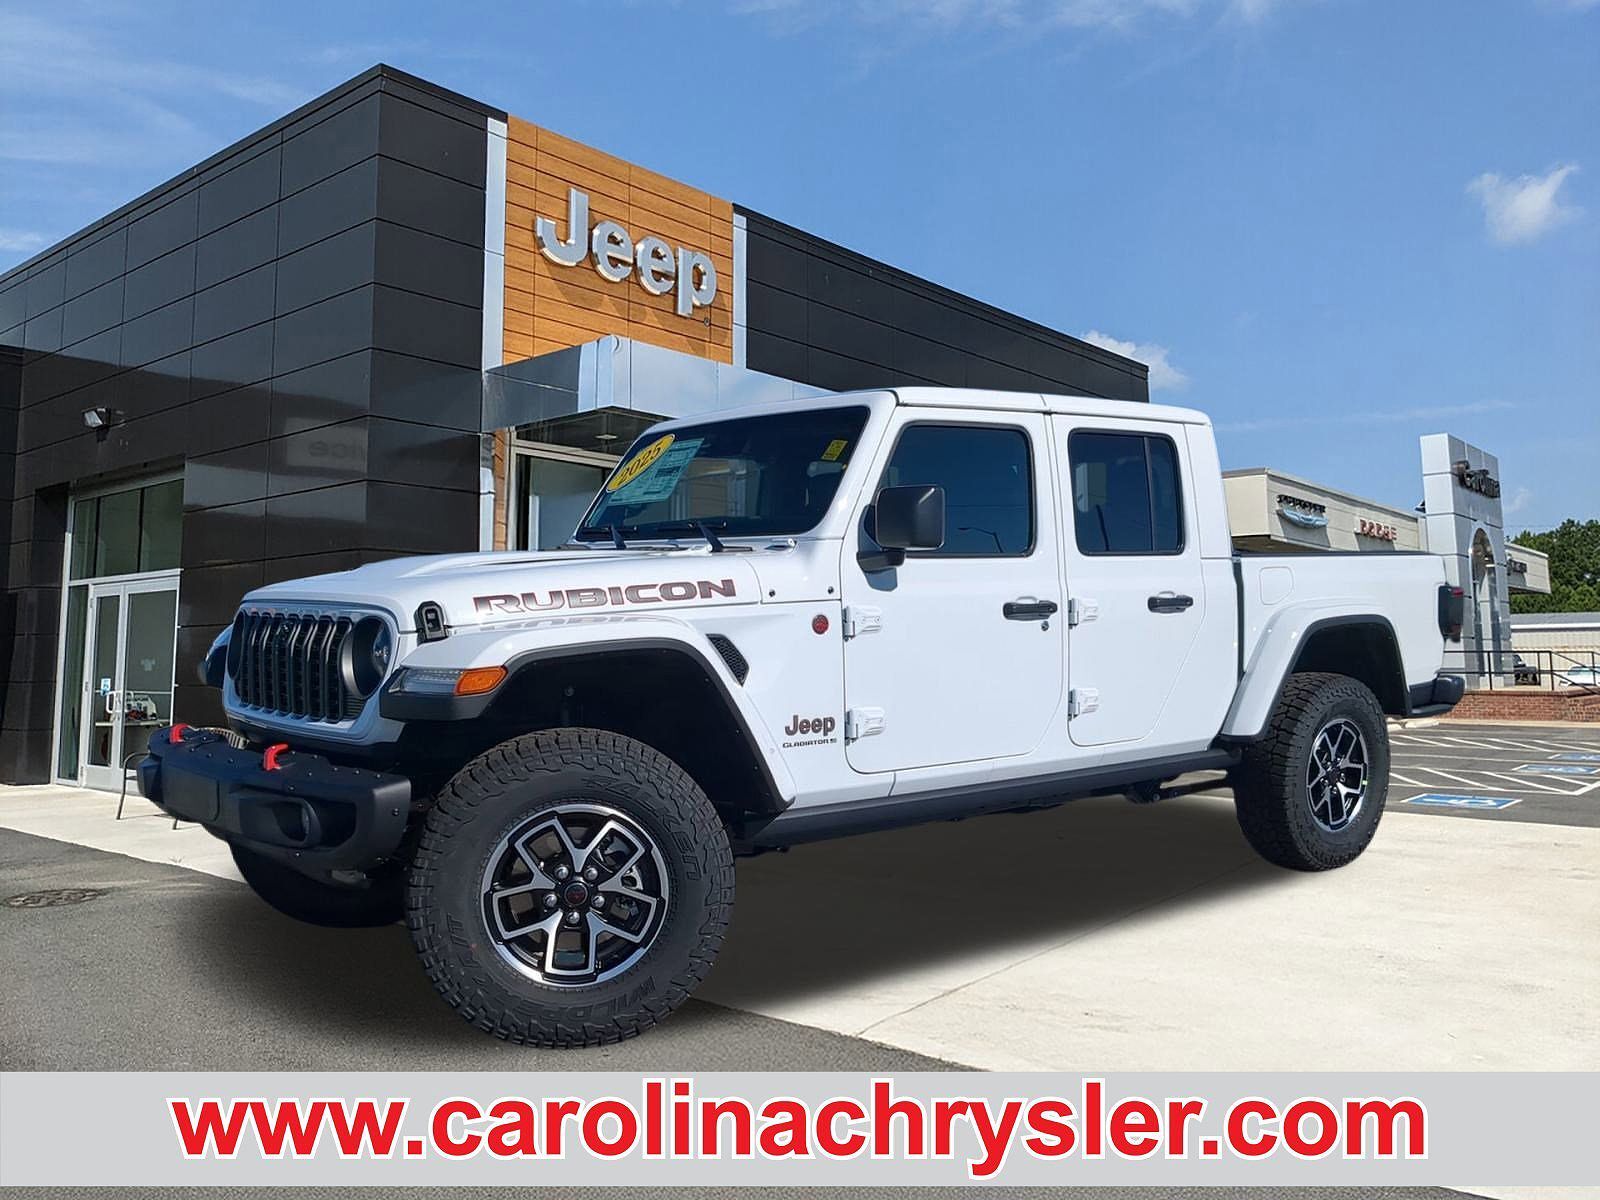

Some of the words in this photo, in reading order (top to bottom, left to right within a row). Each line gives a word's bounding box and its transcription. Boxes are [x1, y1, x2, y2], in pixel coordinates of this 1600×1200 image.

[535, 187, 718, 317] Jeep
[617, 441, 662, 485] 2025
[473, 579, 738, 615] RUBICON
[783, 739, 829, 748] GLADIATOR
[785, 715, 836, 737] Jeep
